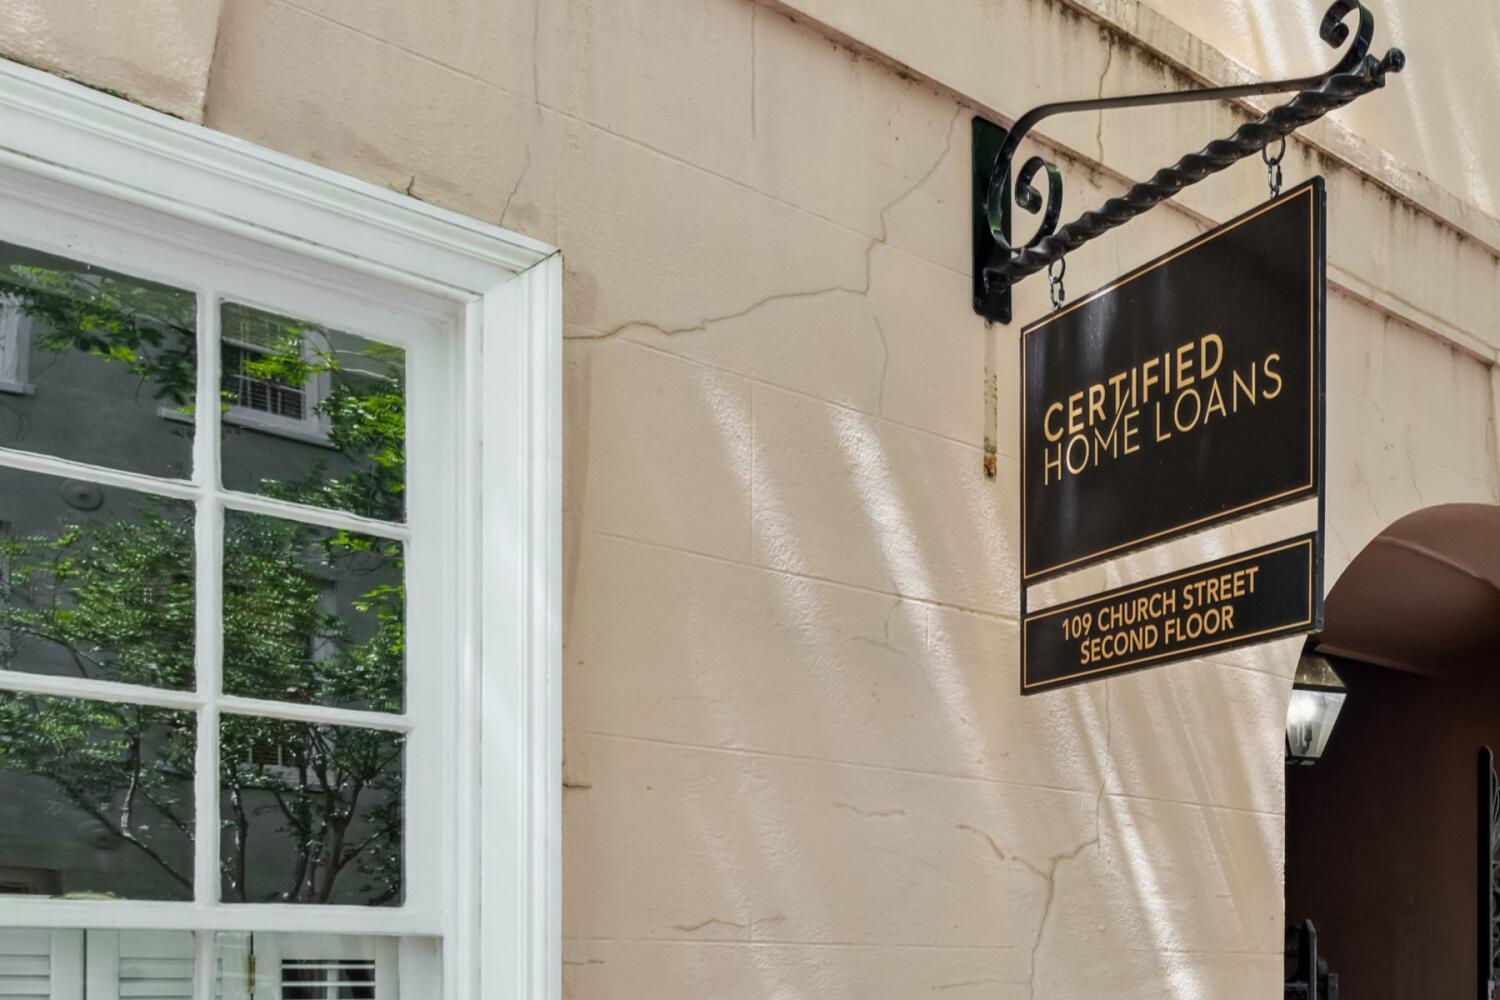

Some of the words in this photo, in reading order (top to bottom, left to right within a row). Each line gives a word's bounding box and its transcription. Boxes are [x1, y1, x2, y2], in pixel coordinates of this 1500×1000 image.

[1043, 333, 1224, 442] CERTIFIED
[1043, 387, 1140, 486] HOME
[1155, 353, 1283, 443] LOANS
[1062, 613, 1093, 641] 109
[1098, 589, 1176, 632] CHURCH
[1182, 566, 1260, 611] STREET
[1080, 624, 1158, 665] SECOND
[1164, 605, 1235, 645] FLOOR
